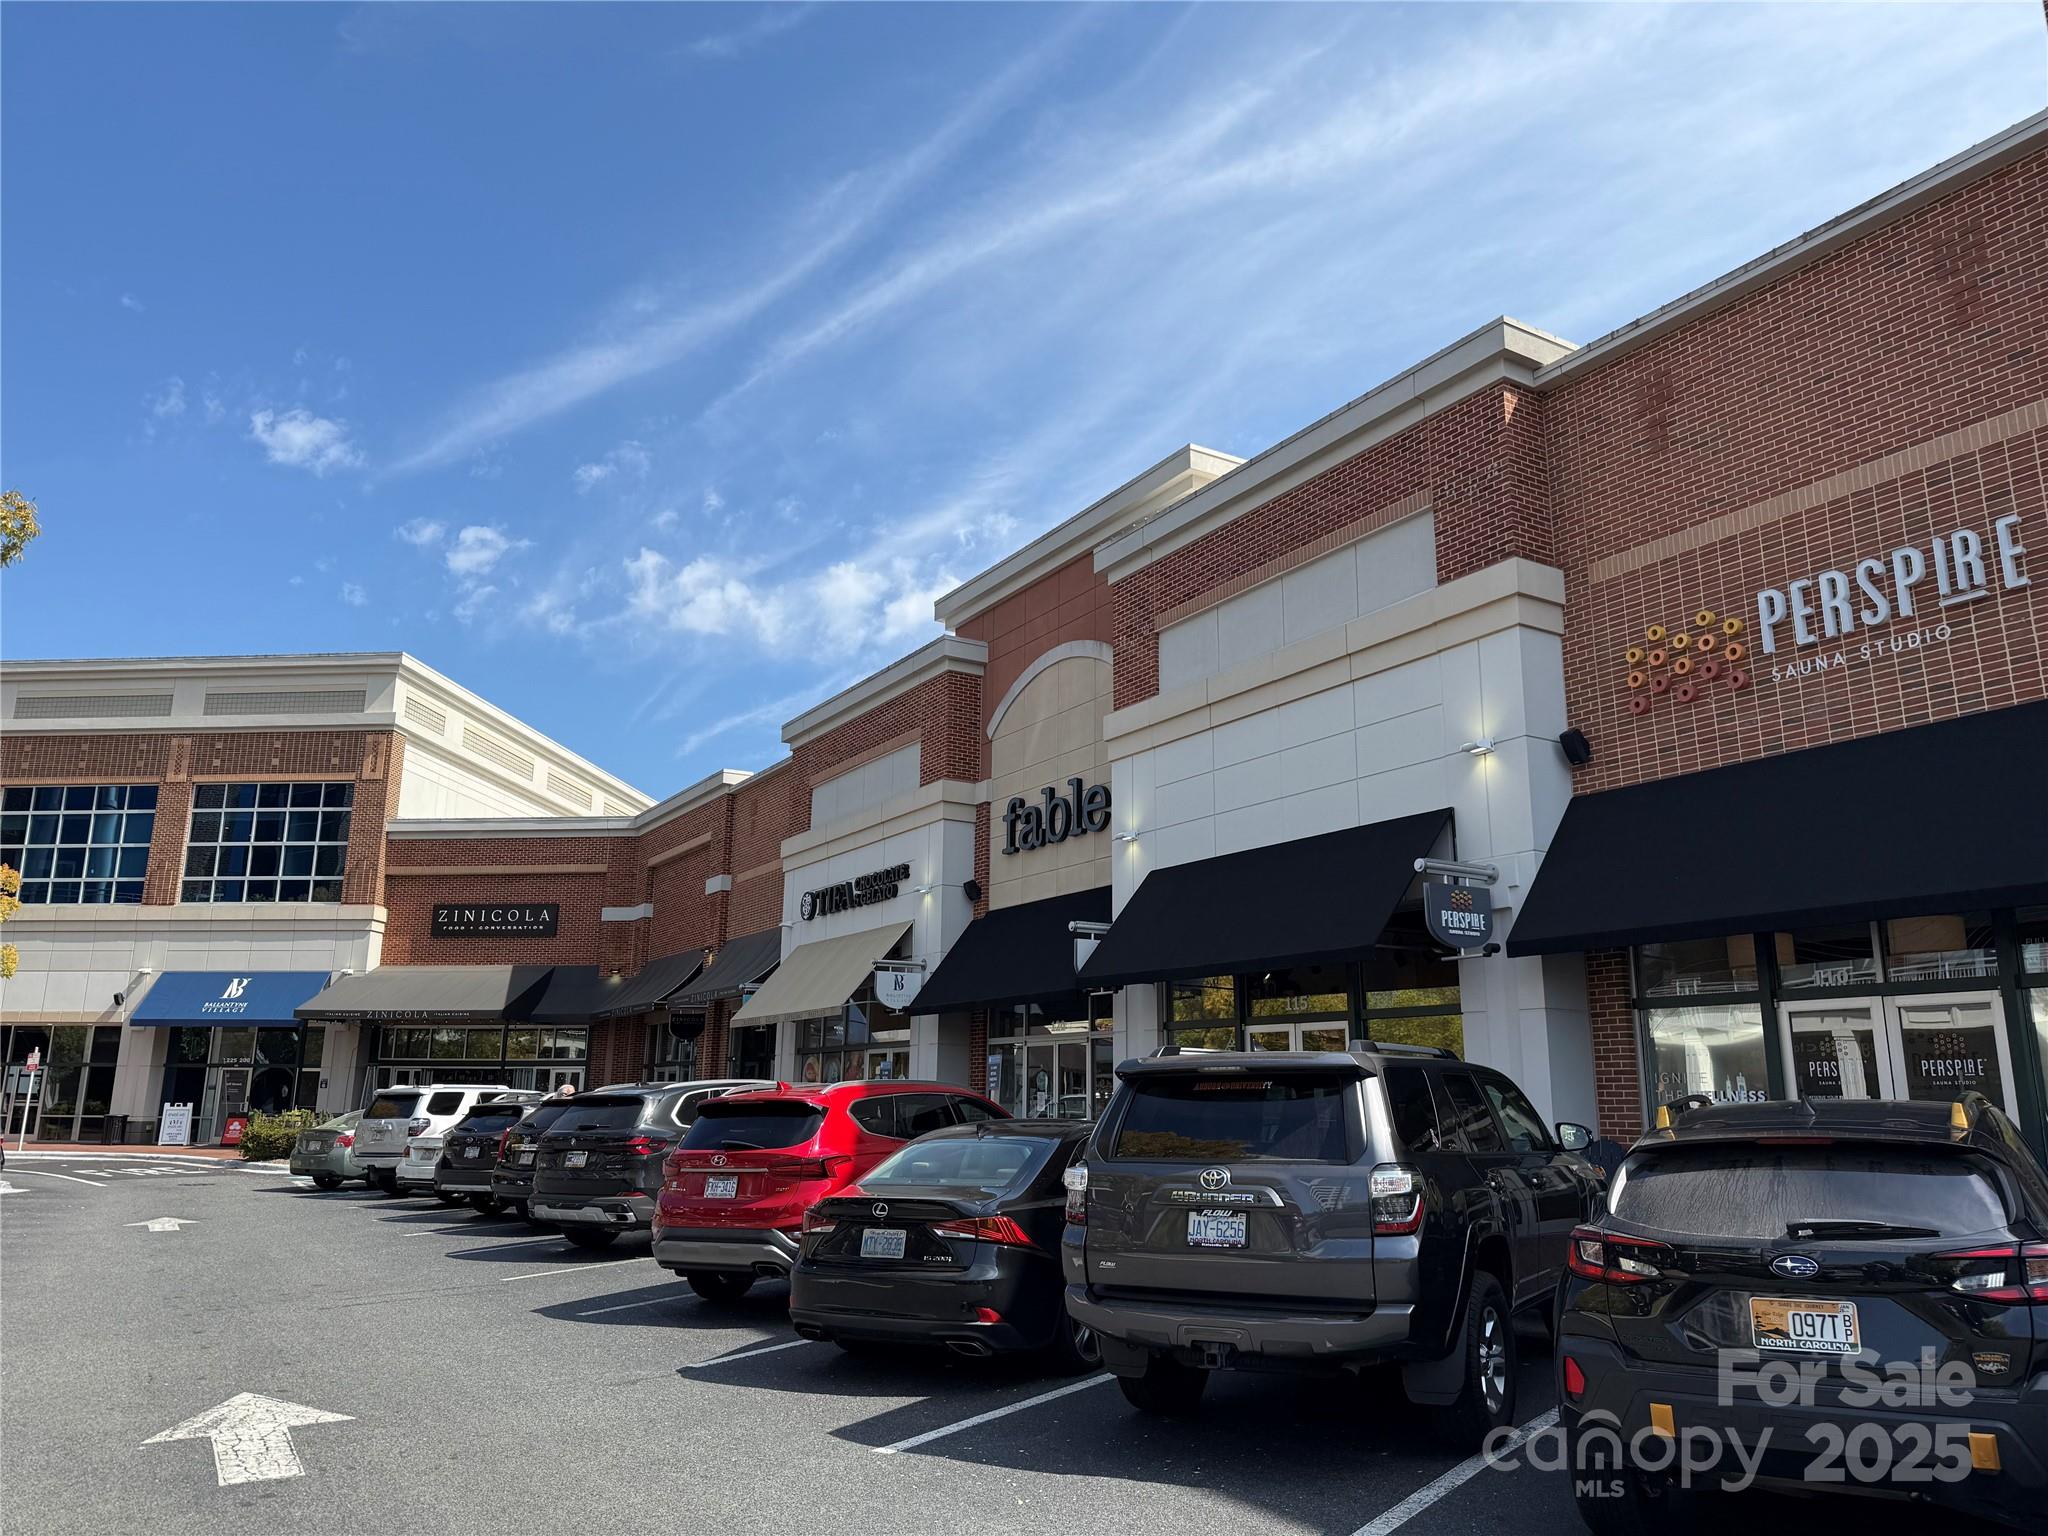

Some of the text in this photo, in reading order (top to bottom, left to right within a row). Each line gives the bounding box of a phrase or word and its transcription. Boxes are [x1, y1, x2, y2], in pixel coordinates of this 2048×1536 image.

[1757, 514, 2031, 655] PERSPIRE
[1771, 624, 1952, 682] SAUNA STUDIO
[1002, 777, 1112, 855] fable
[854, 863, 910, 891] CHOCOLATES
[861, 883, 898, 905] GELATO
[438, 908, 550, 922] ZINICOLA
[1441, 910, 1486, 931] PERSPIRE
[1285, 996, 1308, 1010] 115
[367, 1010, 428, 1018] ZINICOLA
[1921, 1056, 1985, 1076] PERSPIRE
[1654, 1072, 1709, 1084] IGNITE
[1656, 1090, 1682, 1100] THE
[1189, 1220, 1244, 1239] JAY-6256
[1792, 1312, 1838, 1339] 097T
[1760, 1337, 1852, 1351] NORTH CAROLINA
